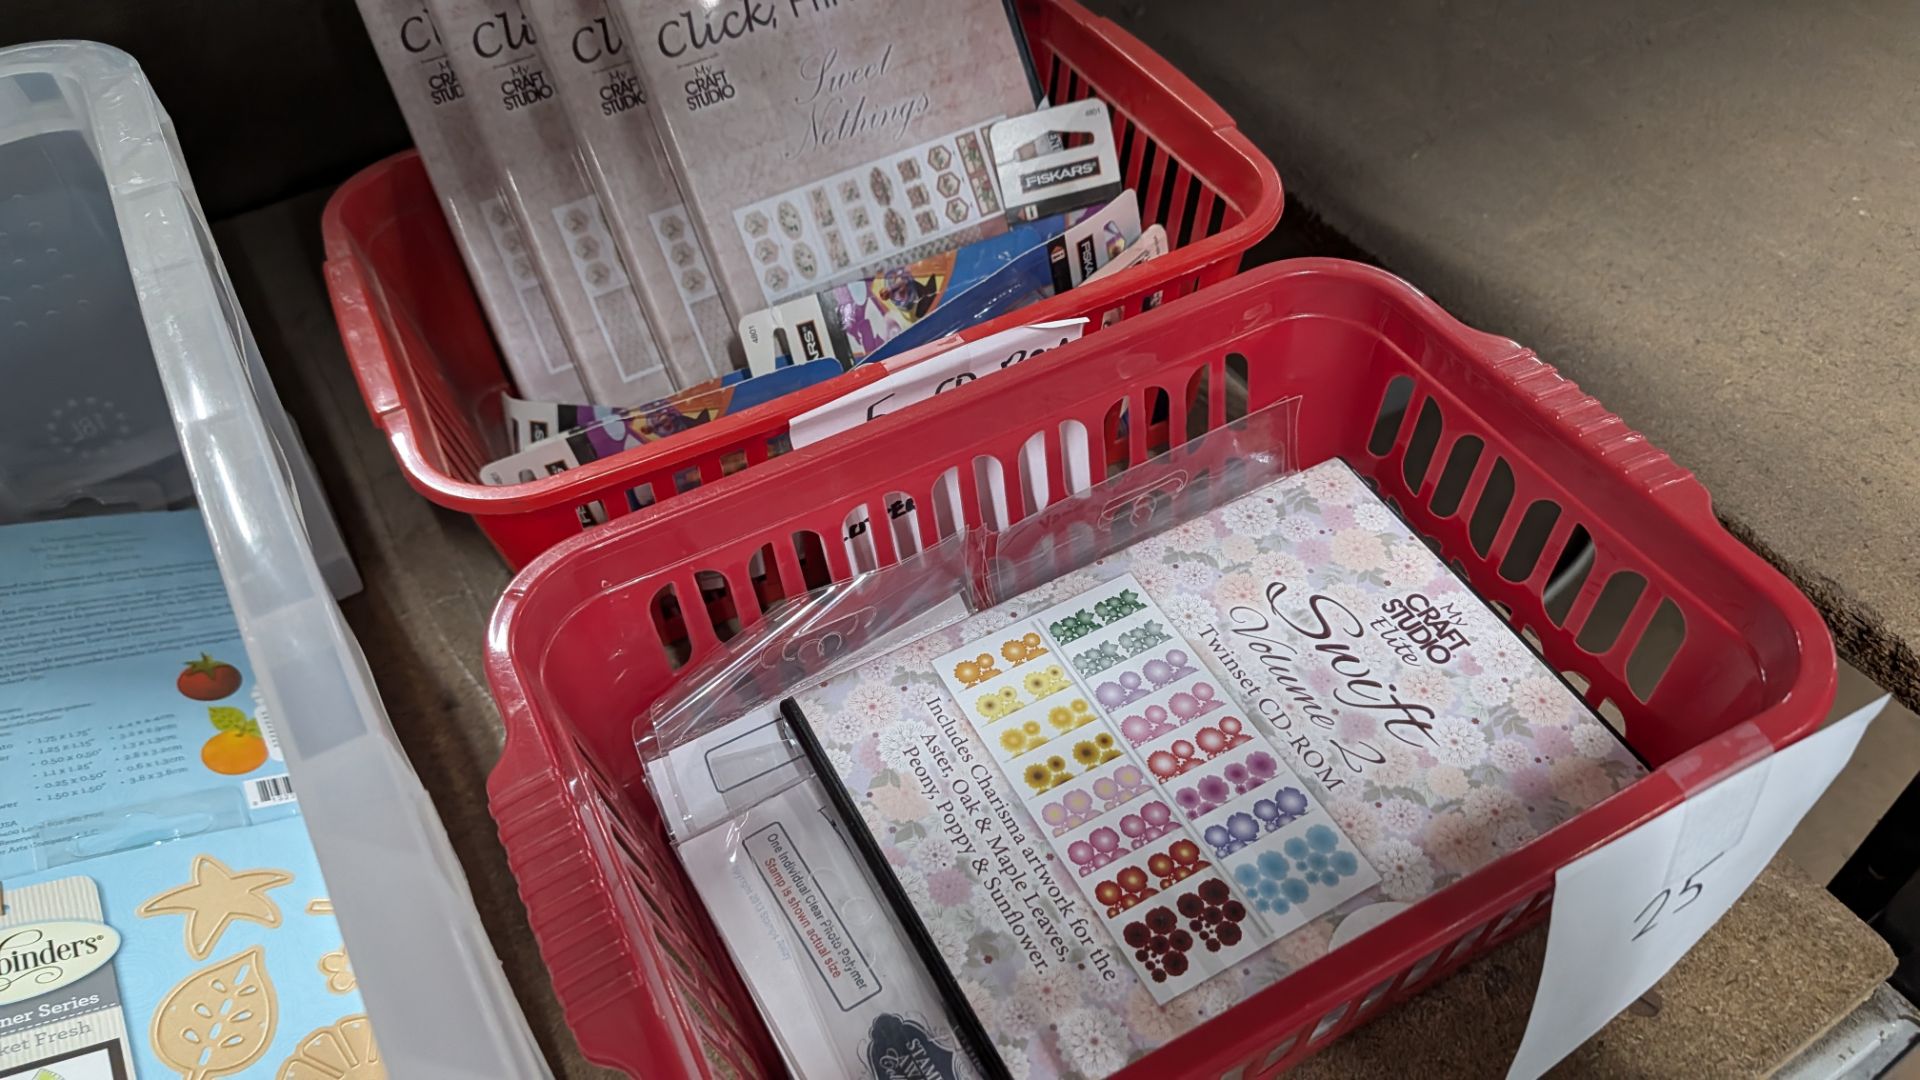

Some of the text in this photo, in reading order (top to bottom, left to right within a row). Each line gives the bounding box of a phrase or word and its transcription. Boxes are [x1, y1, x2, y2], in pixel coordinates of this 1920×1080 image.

[501, 71, 546, 96] CRAFT
[503, 84, 554, 111] STUDIO
[599, 76, 639, 101] CRAF
[684, 70, 729, 96] CRAFT
[686, 84, 736, 112] STUDIO
[795, 43, 893, 105] Sweet
[780, 92, 930, 160] Nothings
[1369, 615, 1422, 667] Elite
[1381, 598, 1453, 665] STUDIO
[1405, 593, 1472, 651] CRAFT
[1440, 602, 1469, 627] My
[1229, 606, 1387, 774] Volume 2
[1266, 581, 1440, 749] Swift
[1199, 623, 1346, 791] Twinset CD-ROM
[902, 745, 1050, 975] Peony, Poppy & Sunflower.
[921, 732, 1071, 962] Aster, Oak & Maple Leaves,
[927, 696, 1117, 982] Includes Charisma artwork for the
[764, 857, 842, 979] Stamp is shown actual size
[767, 832, 868, 990] One Individual Clear Photo Polymer
[1631, 851, 1725, 942] 25
[34, 1020, 94, 1047] Fresh
[38, 993, 100, 1019] Series
[906, 1038, 943, 1080] STAM
